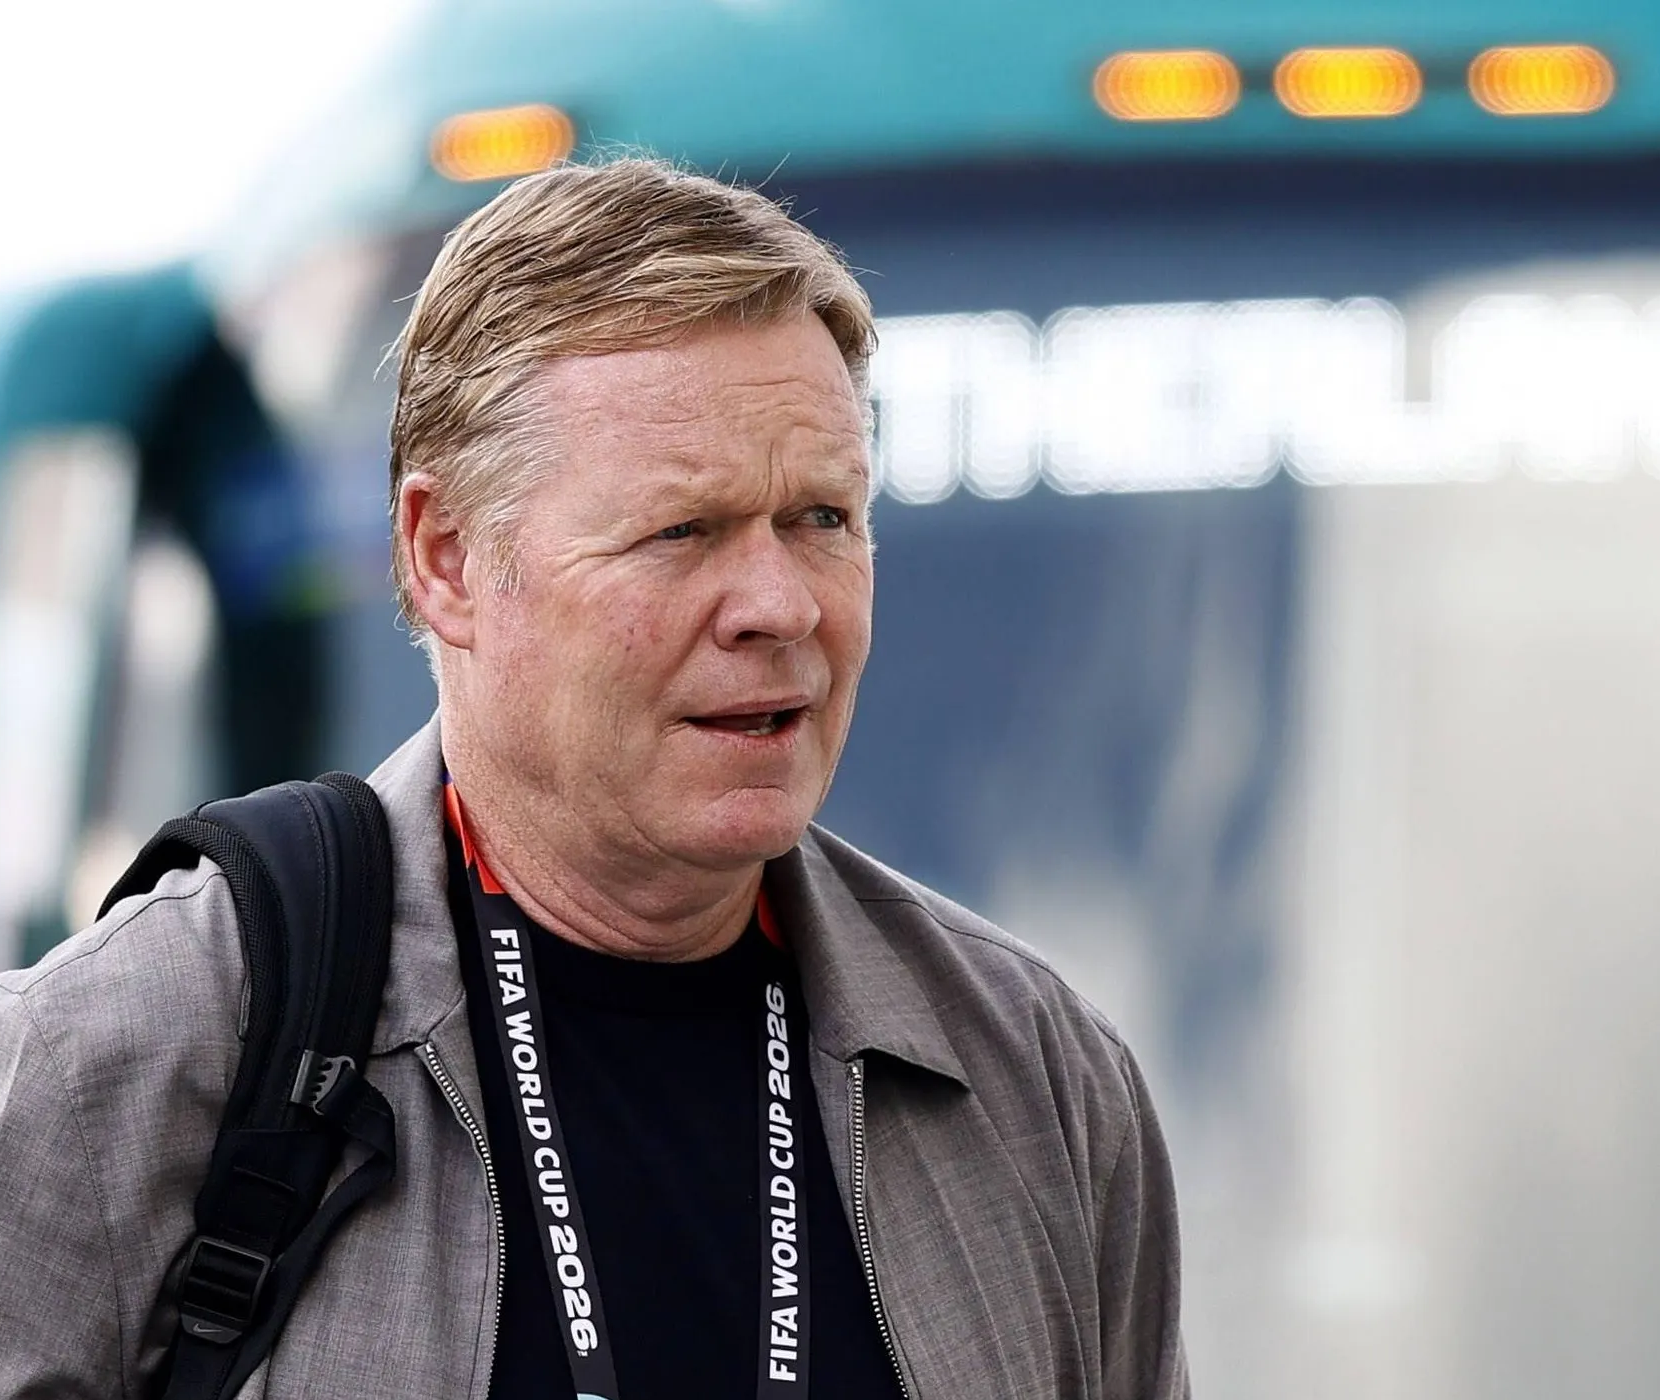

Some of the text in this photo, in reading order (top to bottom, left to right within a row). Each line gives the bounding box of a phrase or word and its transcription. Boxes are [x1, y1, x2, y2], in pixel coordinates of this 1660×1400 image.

[490, 928, 527, 1007] FIFA
[505, 1010, 552, 1141] WORLD
[534, 1147, 570, 1219] CUP
[766, 983, 799, 1382] FIFA WORLD CUP 2026
